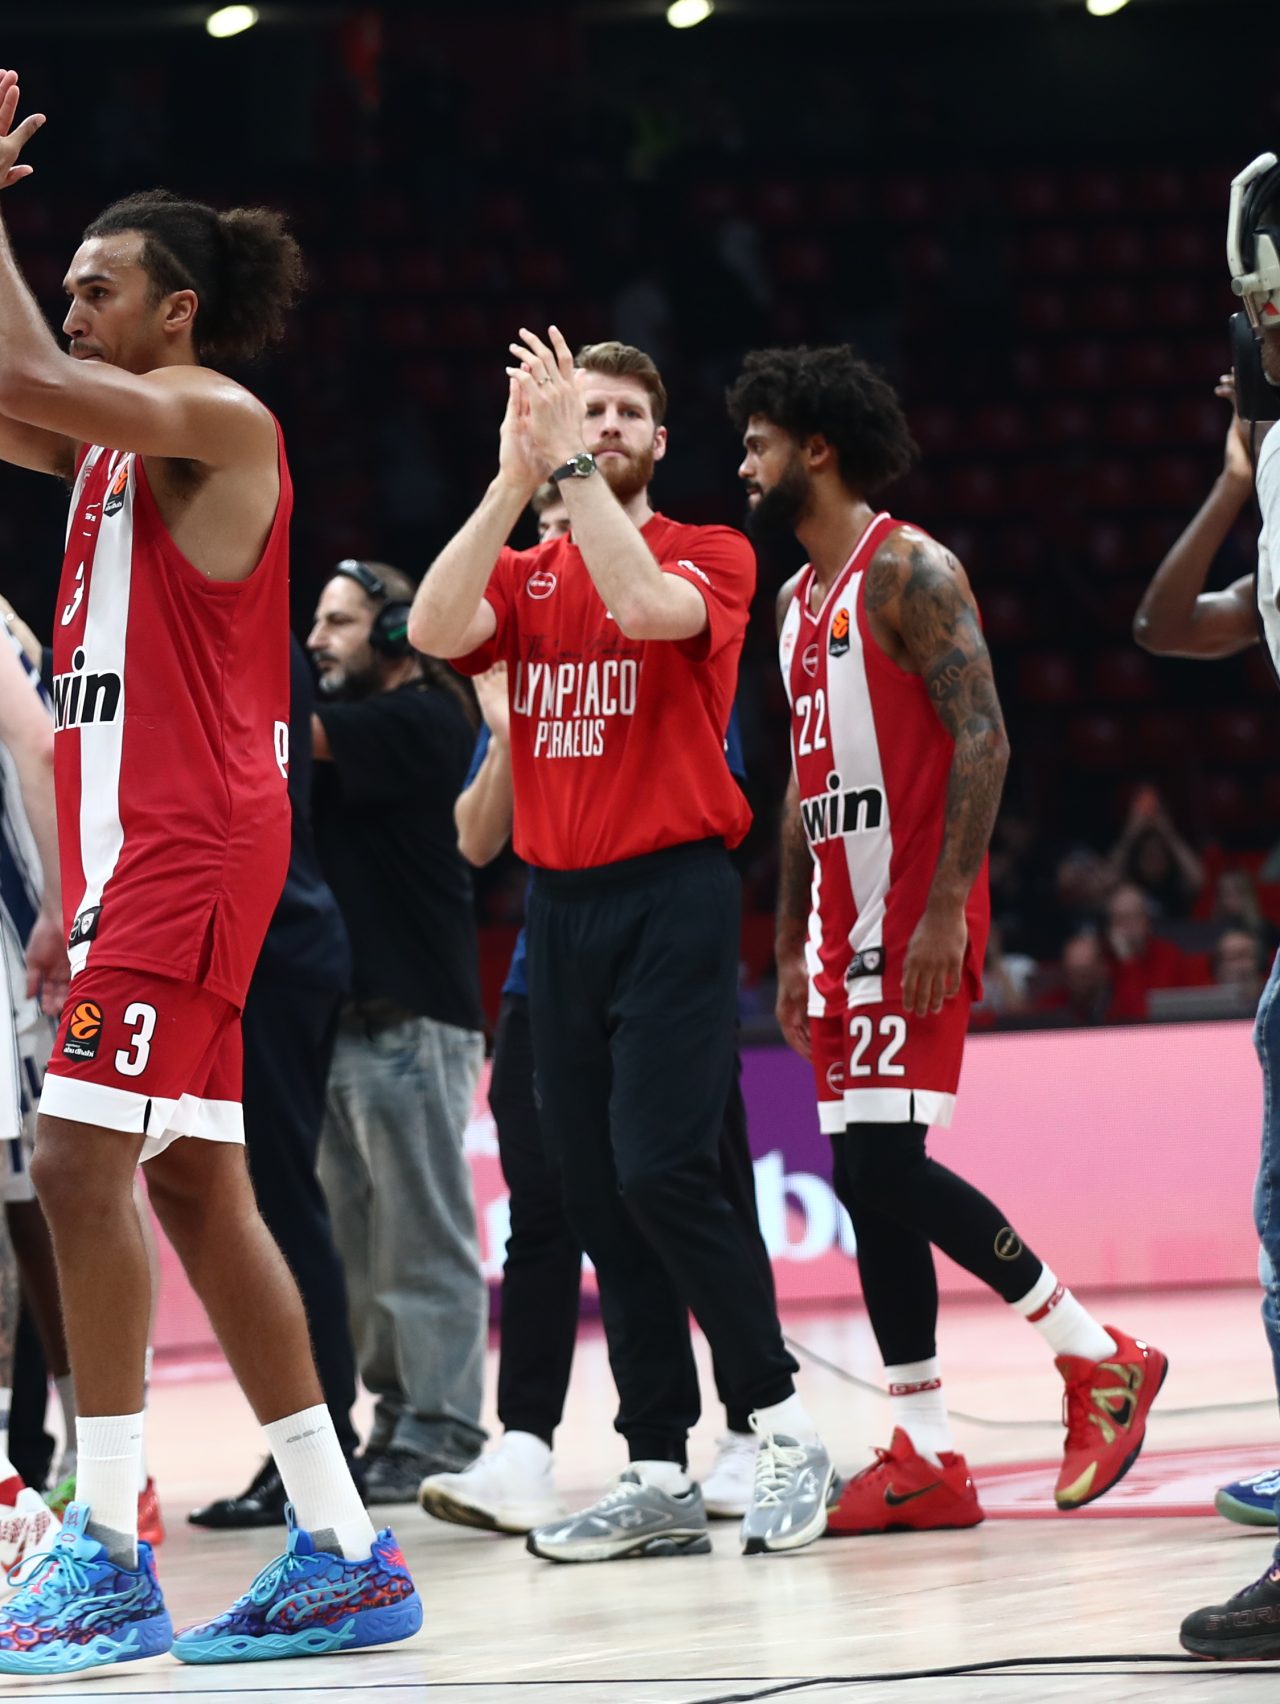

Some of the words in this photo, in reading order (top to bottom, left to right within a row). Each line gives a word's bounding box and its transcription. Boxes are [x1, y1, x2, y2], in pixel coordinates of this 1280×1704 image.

[514, 659, 643, 718] LYMPIACO
[795, 688, 827, 757] 22
[533, 718, 605, 759] PIRAEUS
[801, 769, 887, 846] win
[114, 1002, 157, 1077] 3
[848, 1014, 907, 1078] 22
[752, 1149, 858, 1262] b
